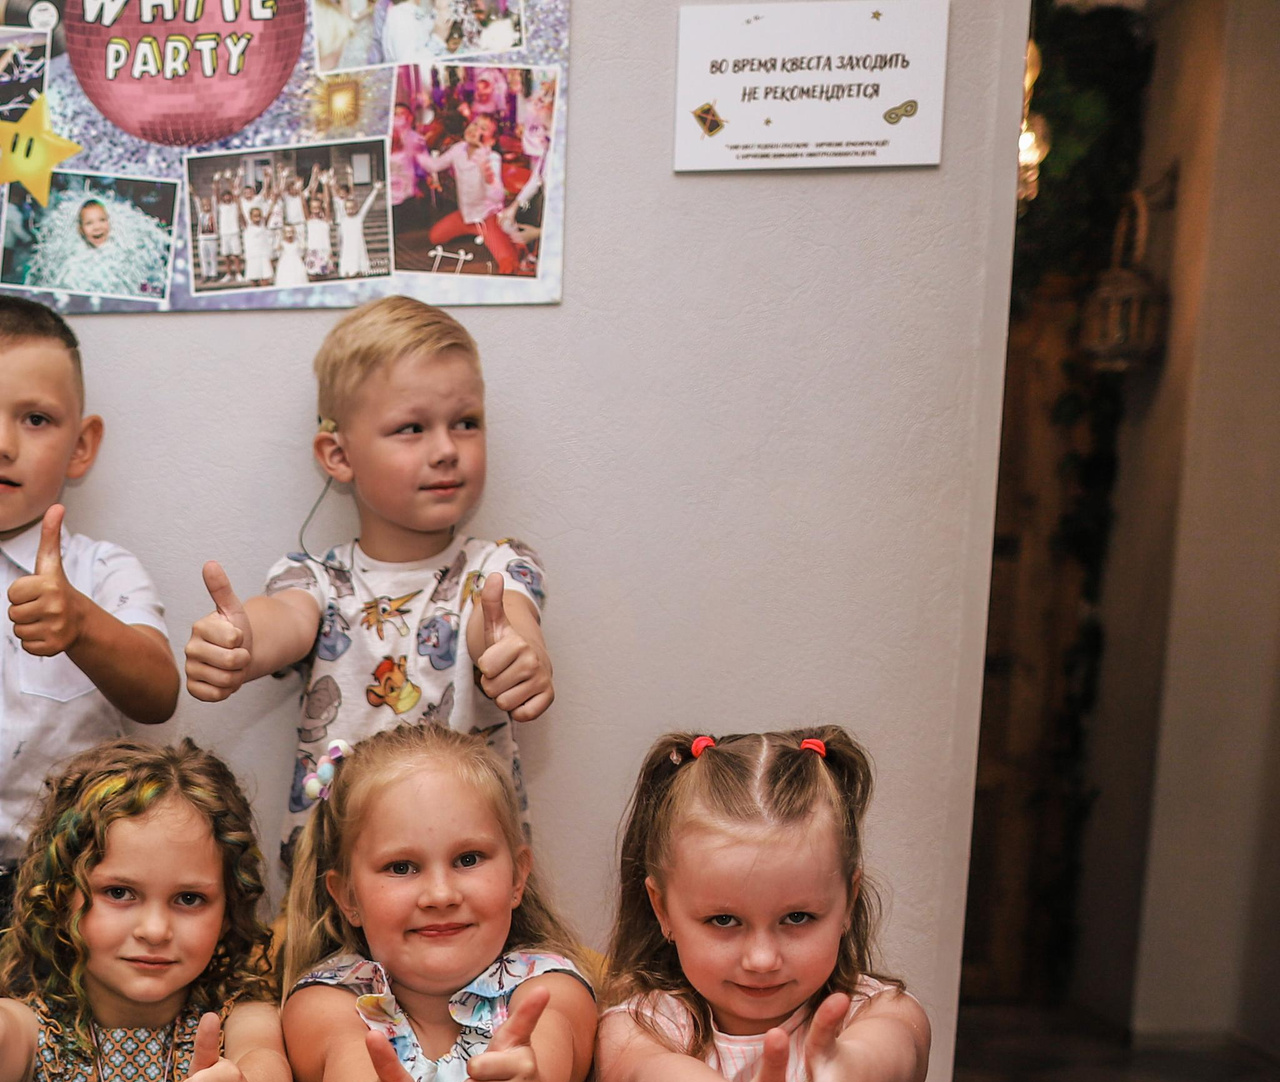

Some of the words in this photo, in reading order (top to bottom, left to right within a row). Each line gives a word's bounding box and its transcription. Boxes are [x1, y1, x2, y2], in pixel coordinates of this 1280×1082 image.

[105, 32, 253, 80] PARTY
[710, 59, 728, 74] ВО
[731, 57, 777, 74] ВРЕМЯ
[780, 55, 833, 73] КВЕСТА
[835, 53, 910, 71] ЗАХОДИТЬ
[740, 85, 760, 102] НЕ
[764, 82, 881, 101] РЕКОМЕНДУЕТСЯ
